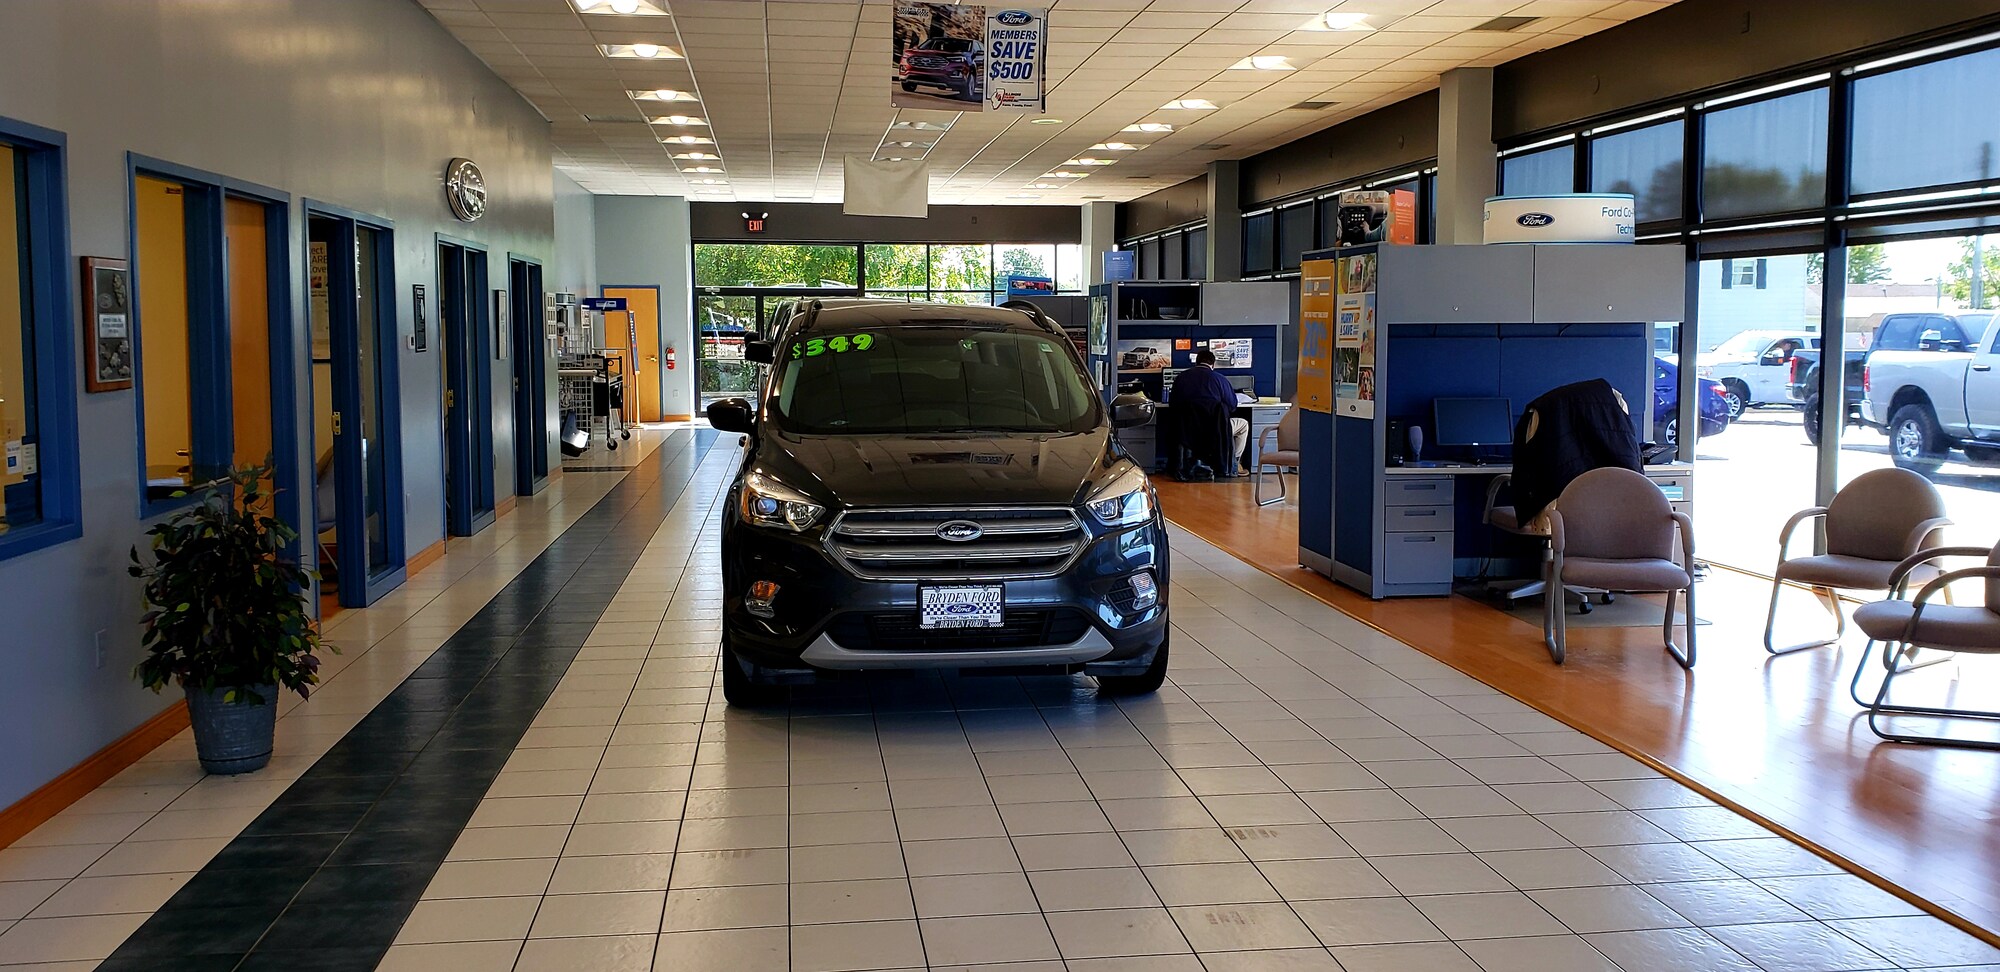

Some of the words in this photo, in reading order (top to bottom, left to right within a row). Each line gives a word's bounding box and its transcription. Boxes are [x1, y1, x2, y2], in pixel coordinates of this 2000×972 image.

[1001, 12, 1027, 24] Ford
[991, 30, 1037, 40] MEMBERS
[990, 41, 1036, 59] SAVE
[989, 60, 1034, 81] $500
[1601, 206, 1623, 217] Ford
[749, 220, 764, 231] EXIT
[1522, 214, 1547, 226] Ford
[792, 334, 873, 359] $349
[928, 592, 970, 603] BRYDEN
[971, 591, 1000, 602] FORD
[951, 604, 972, 613] Ford
[940, 620, 965, 628] BRYDEN
[965, 619, 984, 628] FORD
